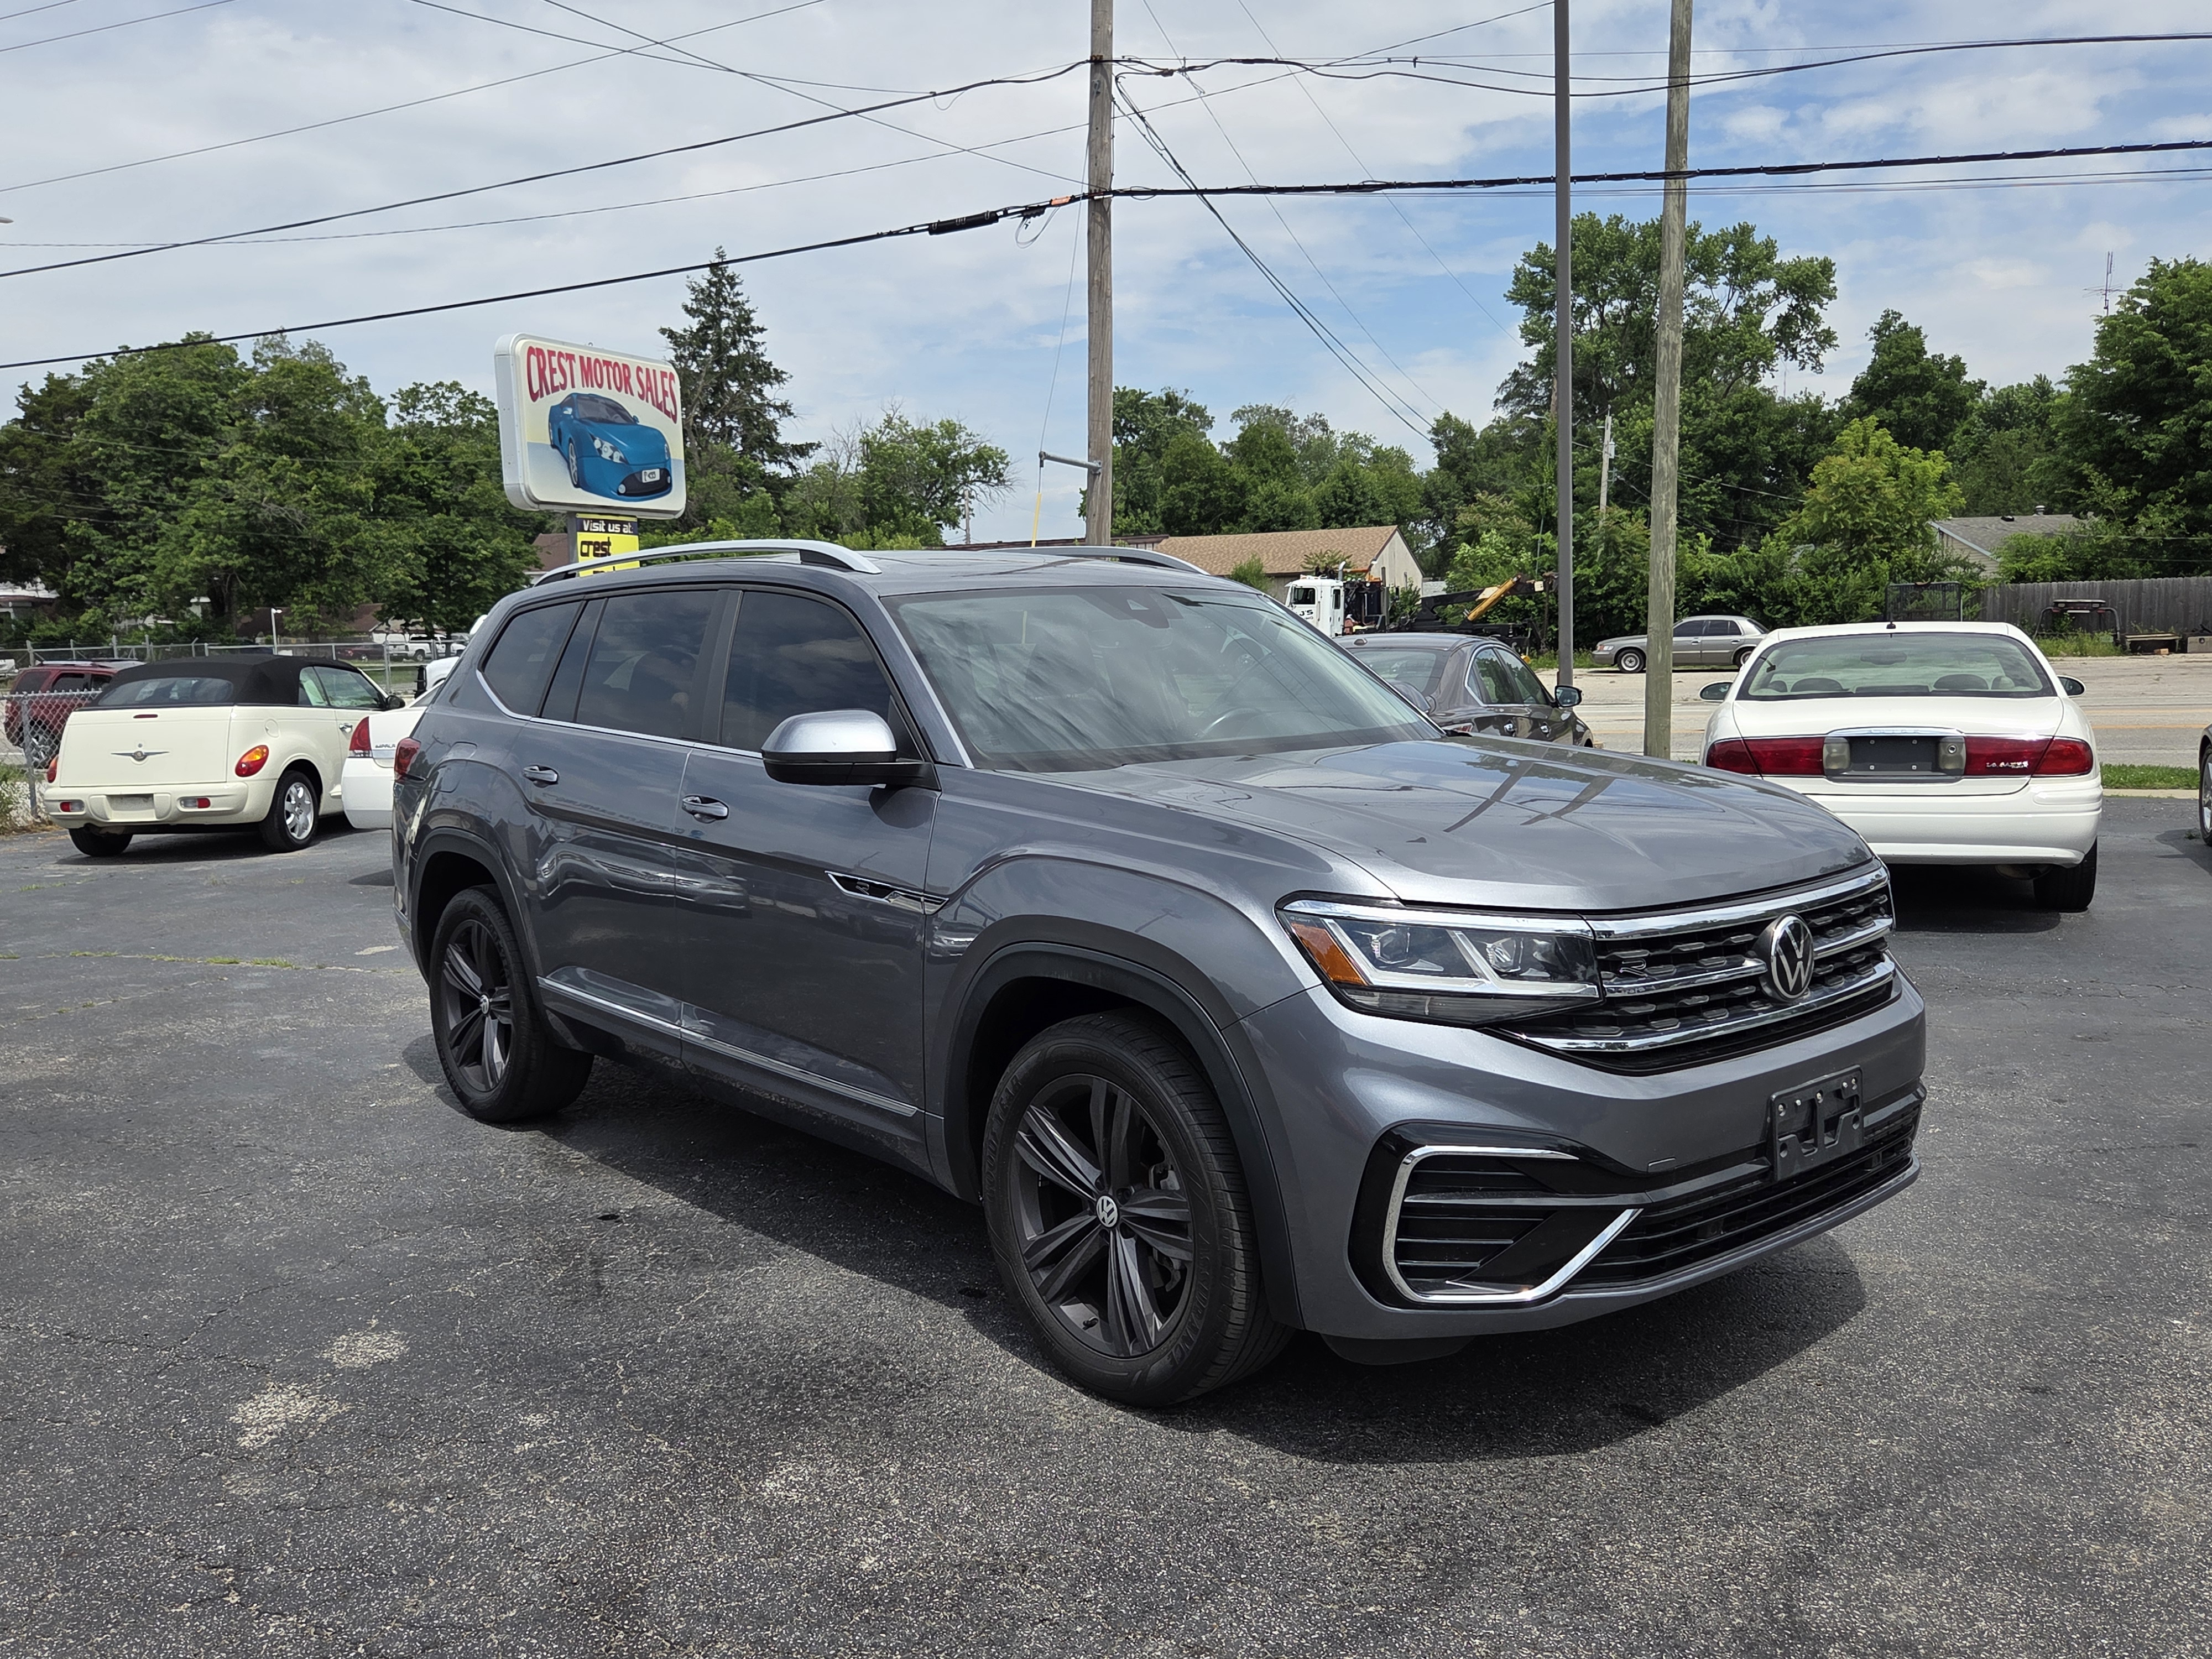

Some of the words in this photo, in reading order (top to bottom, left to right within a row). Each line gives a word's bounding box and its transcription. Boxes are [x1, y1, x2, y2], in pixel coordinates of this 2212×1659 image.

[526, 346, 576, 402] CREST
[579, 356, 634, 396] MOTOR
[636, 366, 677, 424] SALES
[583, 520, 606, 532] Visit
[608, 523, 620, 533] us
[580, 536, 612, 557] crest
